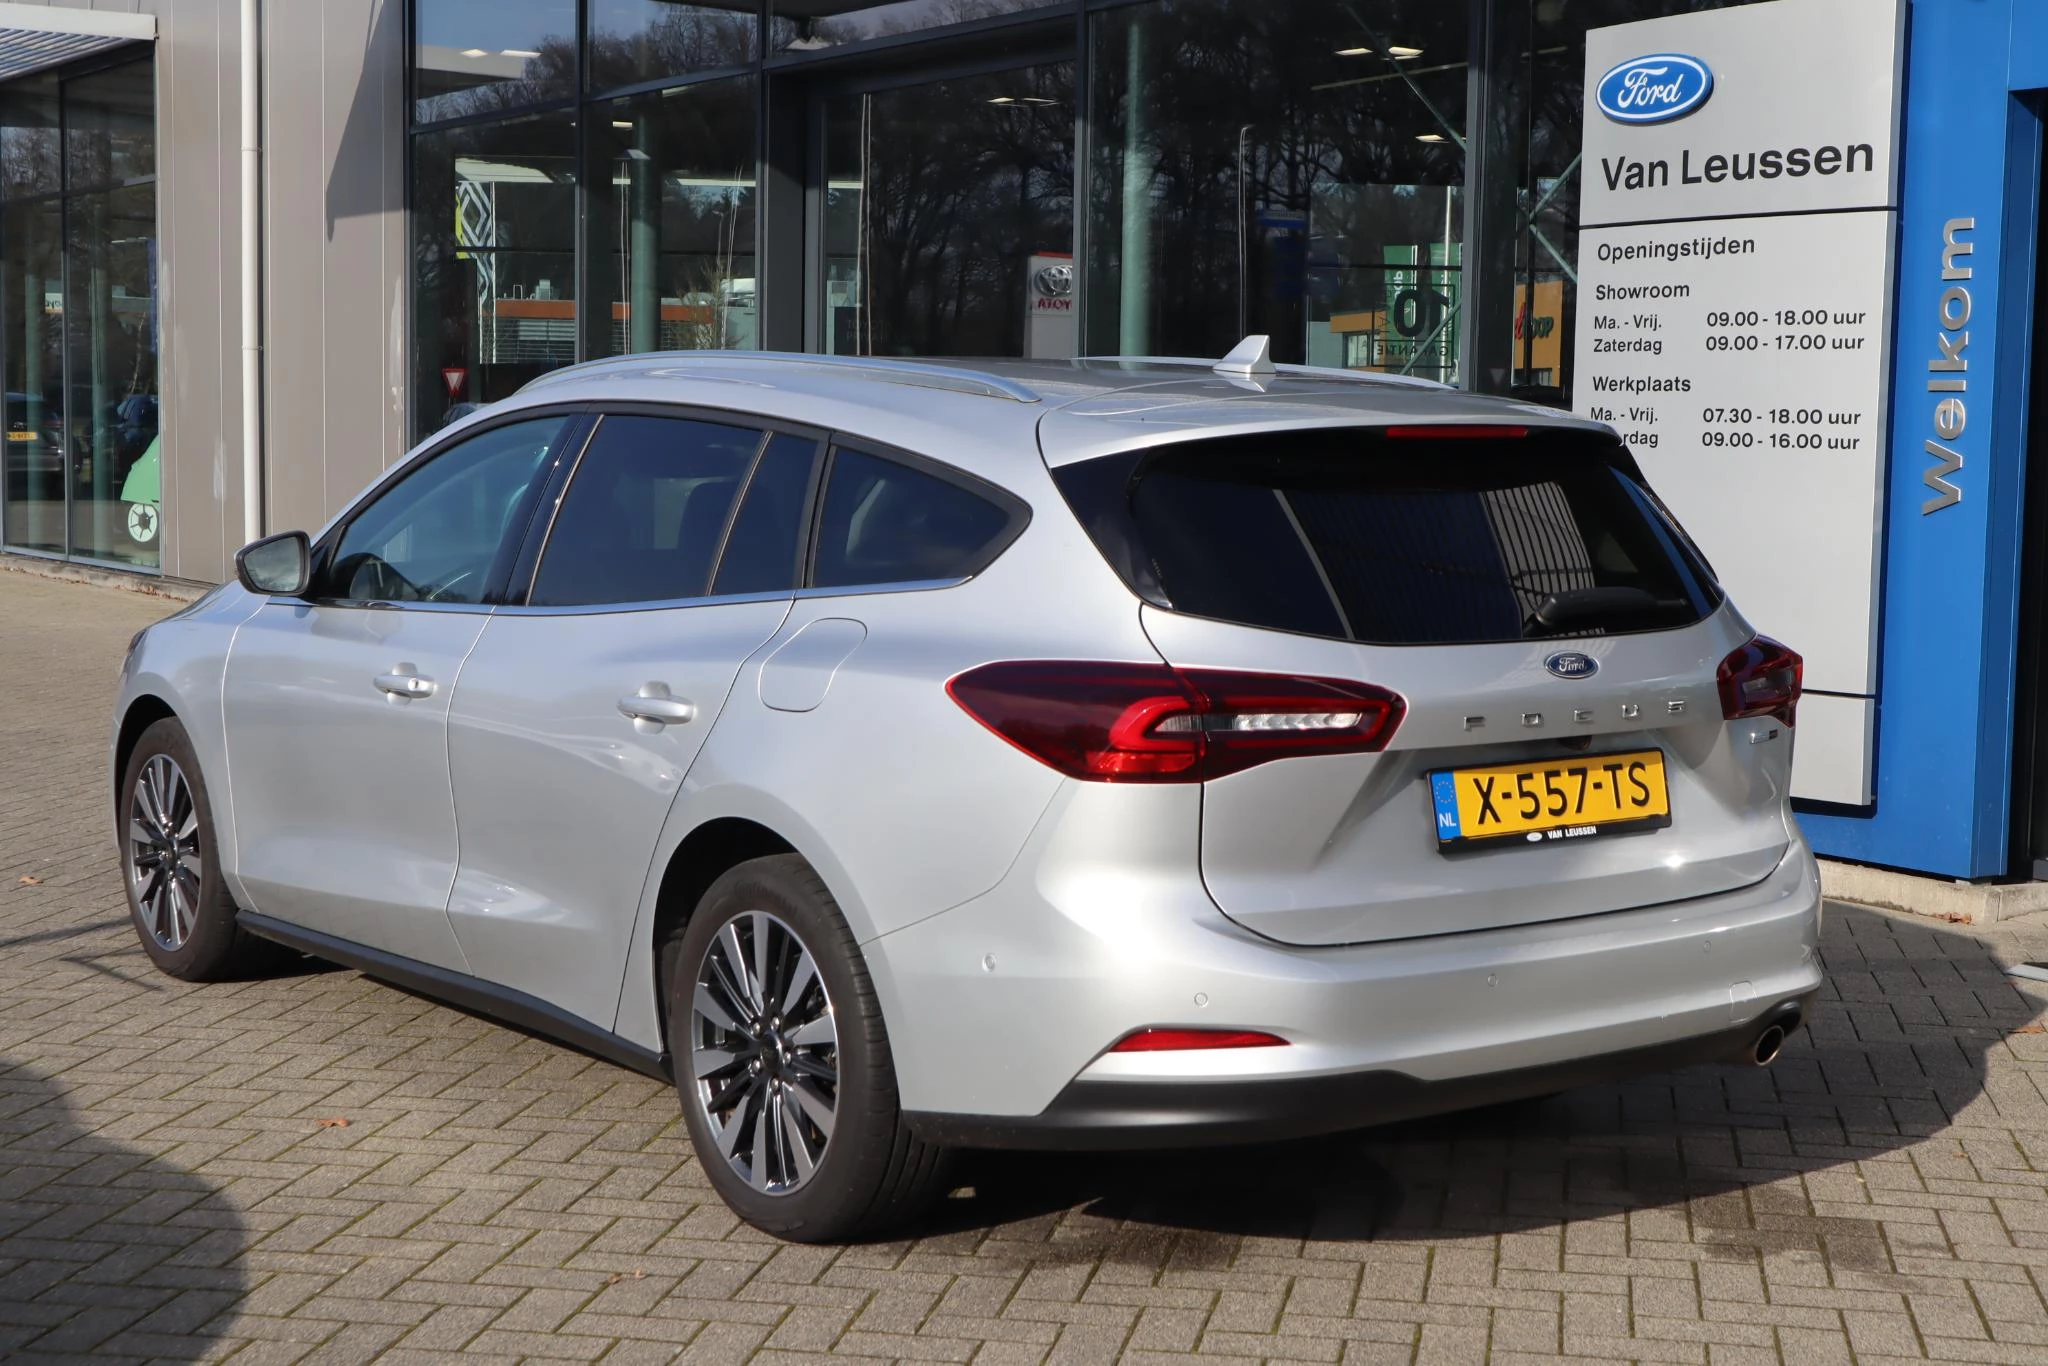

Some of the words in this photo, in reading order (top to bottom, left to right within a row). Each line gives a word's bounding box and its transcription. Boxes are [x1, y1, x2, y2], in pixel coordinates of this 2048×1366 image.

[1617, 66, 1684, 108] Ford
[1601, 156, 1668, 191] Van
[1681, 142, 1873, 184] Leussen
[1597, 237, 1755, 264] Openingstijden
[1595, 283, 1690, 301] Showroom
[1594, 316, 1620, 329] Ma.
[1633, 314, 1662, 331] Vrij.
[1706, 311, 1759, 327] 09.00
[1774, 310, 1828, 326] 18.00
[1833, 310, 1866, 325] uur
[1593, 338, 1663, 355] Zaterdag
[1705, 336, 1758, 352] 09.00
[1774, 335, 1827, 351] 17.00
[1832, 336, 1864, 350] uur
[1922, 217, 1975, 515] Welkom
[1592, 376, 1691, 395] Werkplaats
[1590, 407, 1617, 421] Ma.
[1629, 407, 1659, 424] Vrij.
[1702, 408, 1752, 424] 07.30
[1769, 409, 1823, 425] 18.00
[1828, 411, 1862, 425] uur
[1623, 431, 1659, 448] rdag
[1701, 432, 1754, 448] 09.00
[1769, 433, 1823, 449] 16.00
[1827, 436, 1860, 450] uur
[1463, 699, 1685, 731] FOCUS
[1473, 761, 1651, 825] X-557-TS
[1439, 813, 1456, 829] NL
[1547, 829, 1563, 839] VAN
[1565, 826, 1597, 837] LEUSSEN
